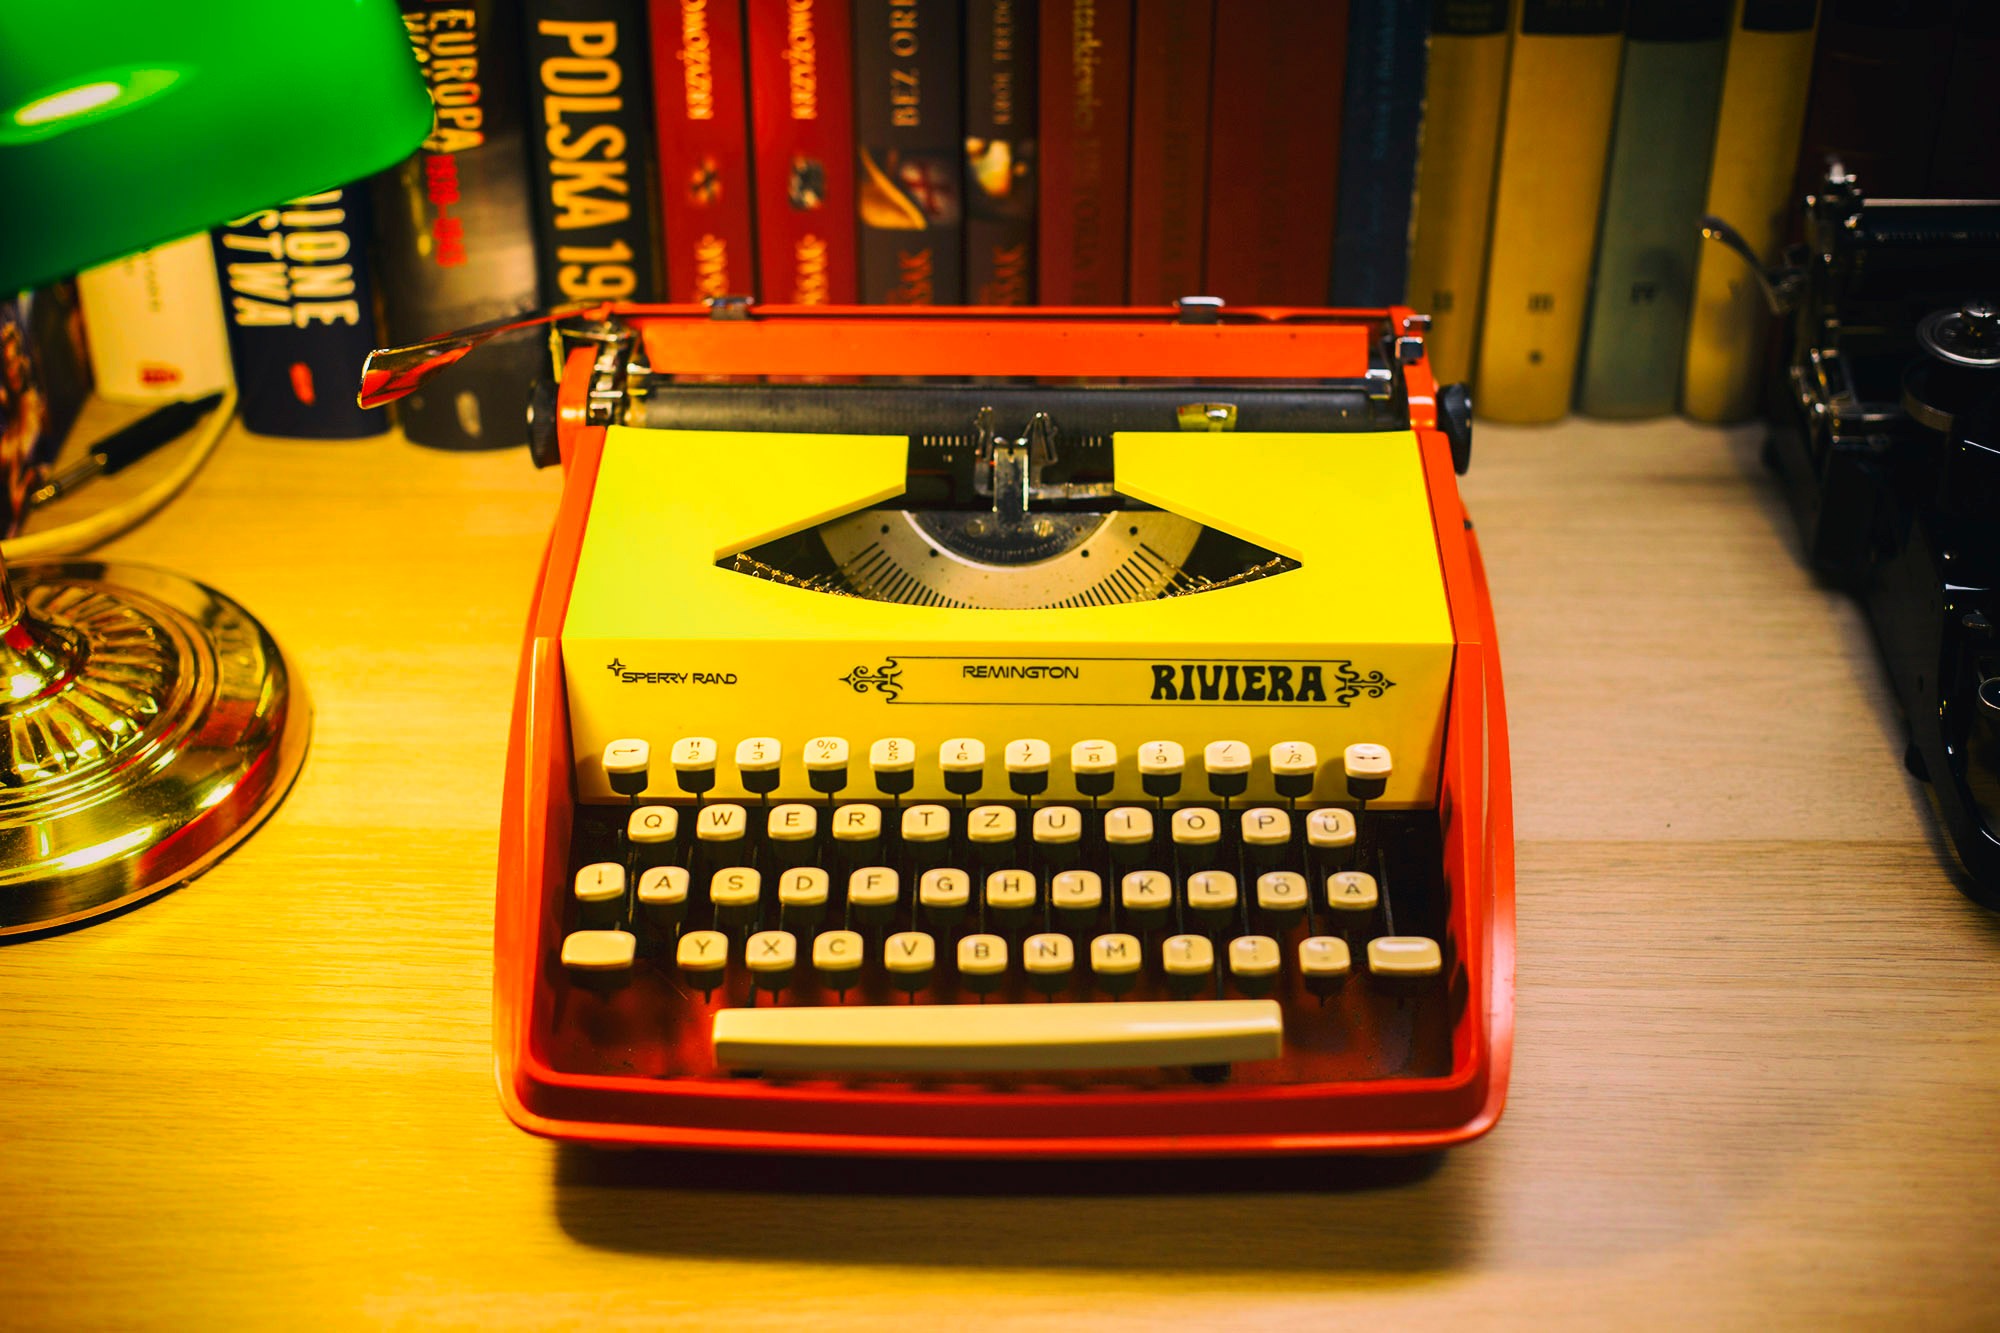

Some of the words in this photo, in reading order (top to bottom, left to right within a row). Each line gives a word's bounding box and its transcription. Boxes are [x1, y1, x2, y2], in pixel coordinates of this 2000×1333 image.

[428, 9, 485, 153] EUROPA
[890, 68, 920, 126] BEZ
[538, 20, 630, 230] POLSKA
[622, 672, 688, 684] SPERRY
[693, 673, 738, 684] RAND
[963, 665, 1079, 679] REMINGTON
[1150, 664, 1327, 702] RIVIERA
[688, 751, 699, 759] 2
[752, 752, 763, 760] 3
[888, 752, 898, 760] 5
[956, 752, 968, 760] 6
[1021, 753, 1032, 761] 7
[1089, 753, 1100, 762] 8
[1155, 755, 1167, 764] 9
[644, 814, 662, 828] Q
[712, 812, 732, 826] W
[785, 812, 800, 826] E
[848, 812, 865, 826] R
[920, 812, 933, 826] T
[984, 813, 1000, 828] Z
[1049, 814, 1065, 828] U
[1187, 815, 1205, 830] O
[1258, 815, 1275, 829] P
[1323, 813, 1340, 833] Ü
[654, 875, 671, 889] A
[728, 875, 743, 890] S
[796, 876, 813, 890] D
[867, 874, 881, 890] F
[936, 877, 953, 891] G
[1003, 877, 1019, 892] H
[1071, 879, 1084, 894] J
[1139, 878, 1153, 894] K
[1205, 880, 1219, 894] L
[1274, 877, 1290, 896] Ö
[1345, 877, 1361, 895] Ä
[695, 940, 711, 955] Y
[763, 939, 780, 955] X
[829, 938, 846, 955] C
[901, 941, 918, 956] V
[974, 943, 990, 959] B
[1039, 942, 1058, 958] N
[1106, 942, 1126, 958] M
